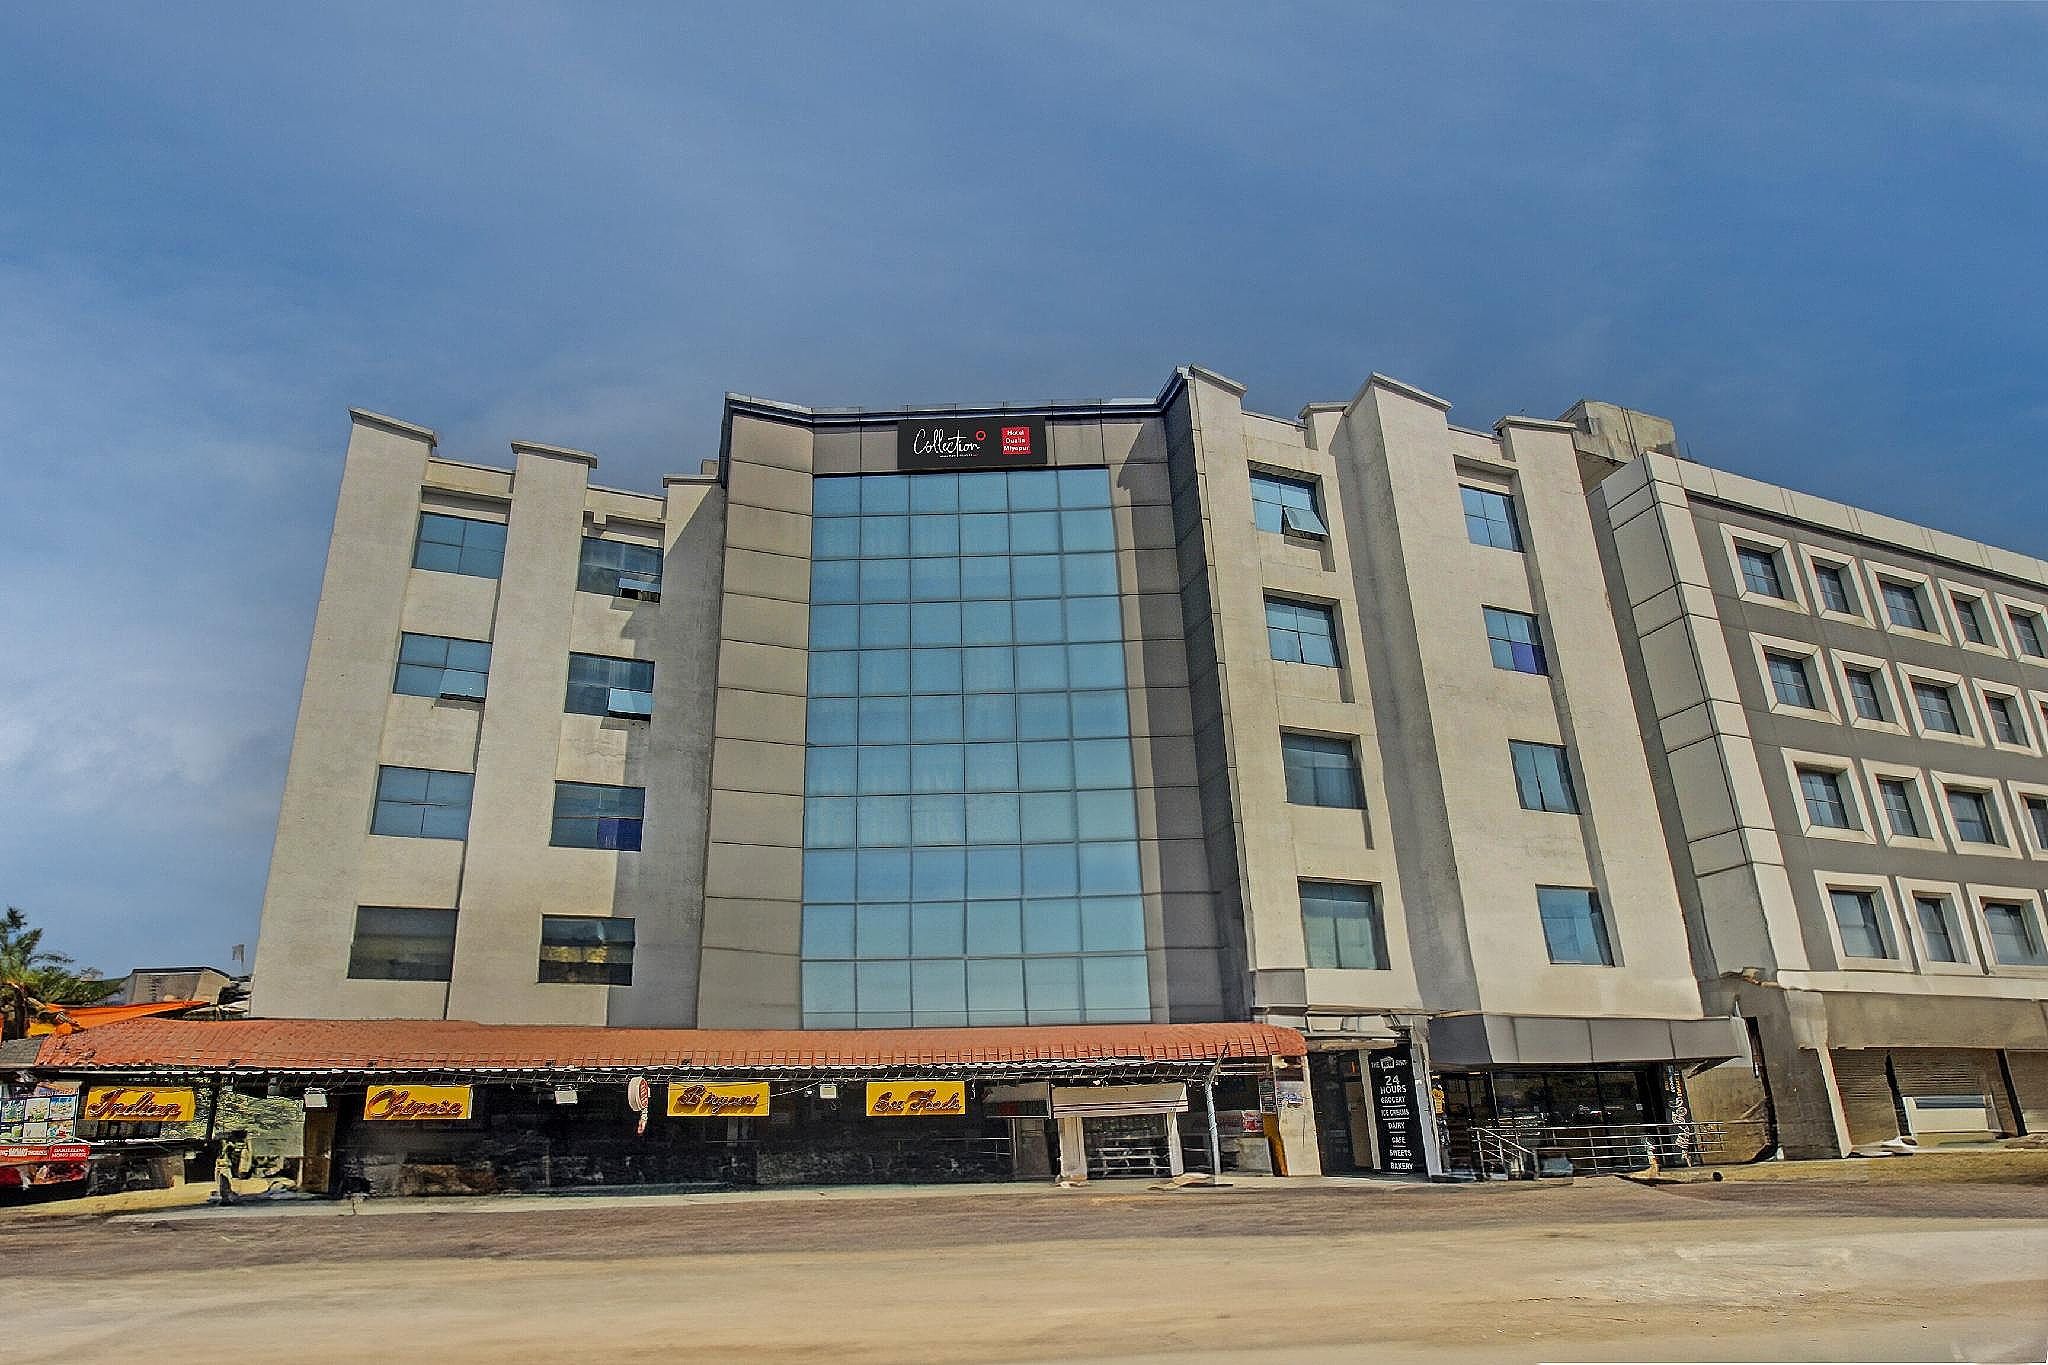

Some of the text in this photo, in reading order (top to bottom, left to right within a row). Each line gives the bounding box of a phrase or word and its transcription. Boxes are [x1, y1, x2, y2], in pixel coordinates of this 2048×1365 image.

[913, 428, 980, 457] Collection
[1384, 1074, 1400, 1085] 24
[1380, 1084, 1407, 1095] HOURS
[88, 1088, 182, 1117] Indian
[367, 1089, 464, 1117] Chinese
[1380, 1095, 1406, 1104] GROCERY
[1387, 1121, 1405, 1129] DAIRY
[1391, 1136, 1407, 1144] CAFE
[1389, 1149, 1412, 1157] SWEETS
[1390, 1161, 1414, 1170] BAKERY
